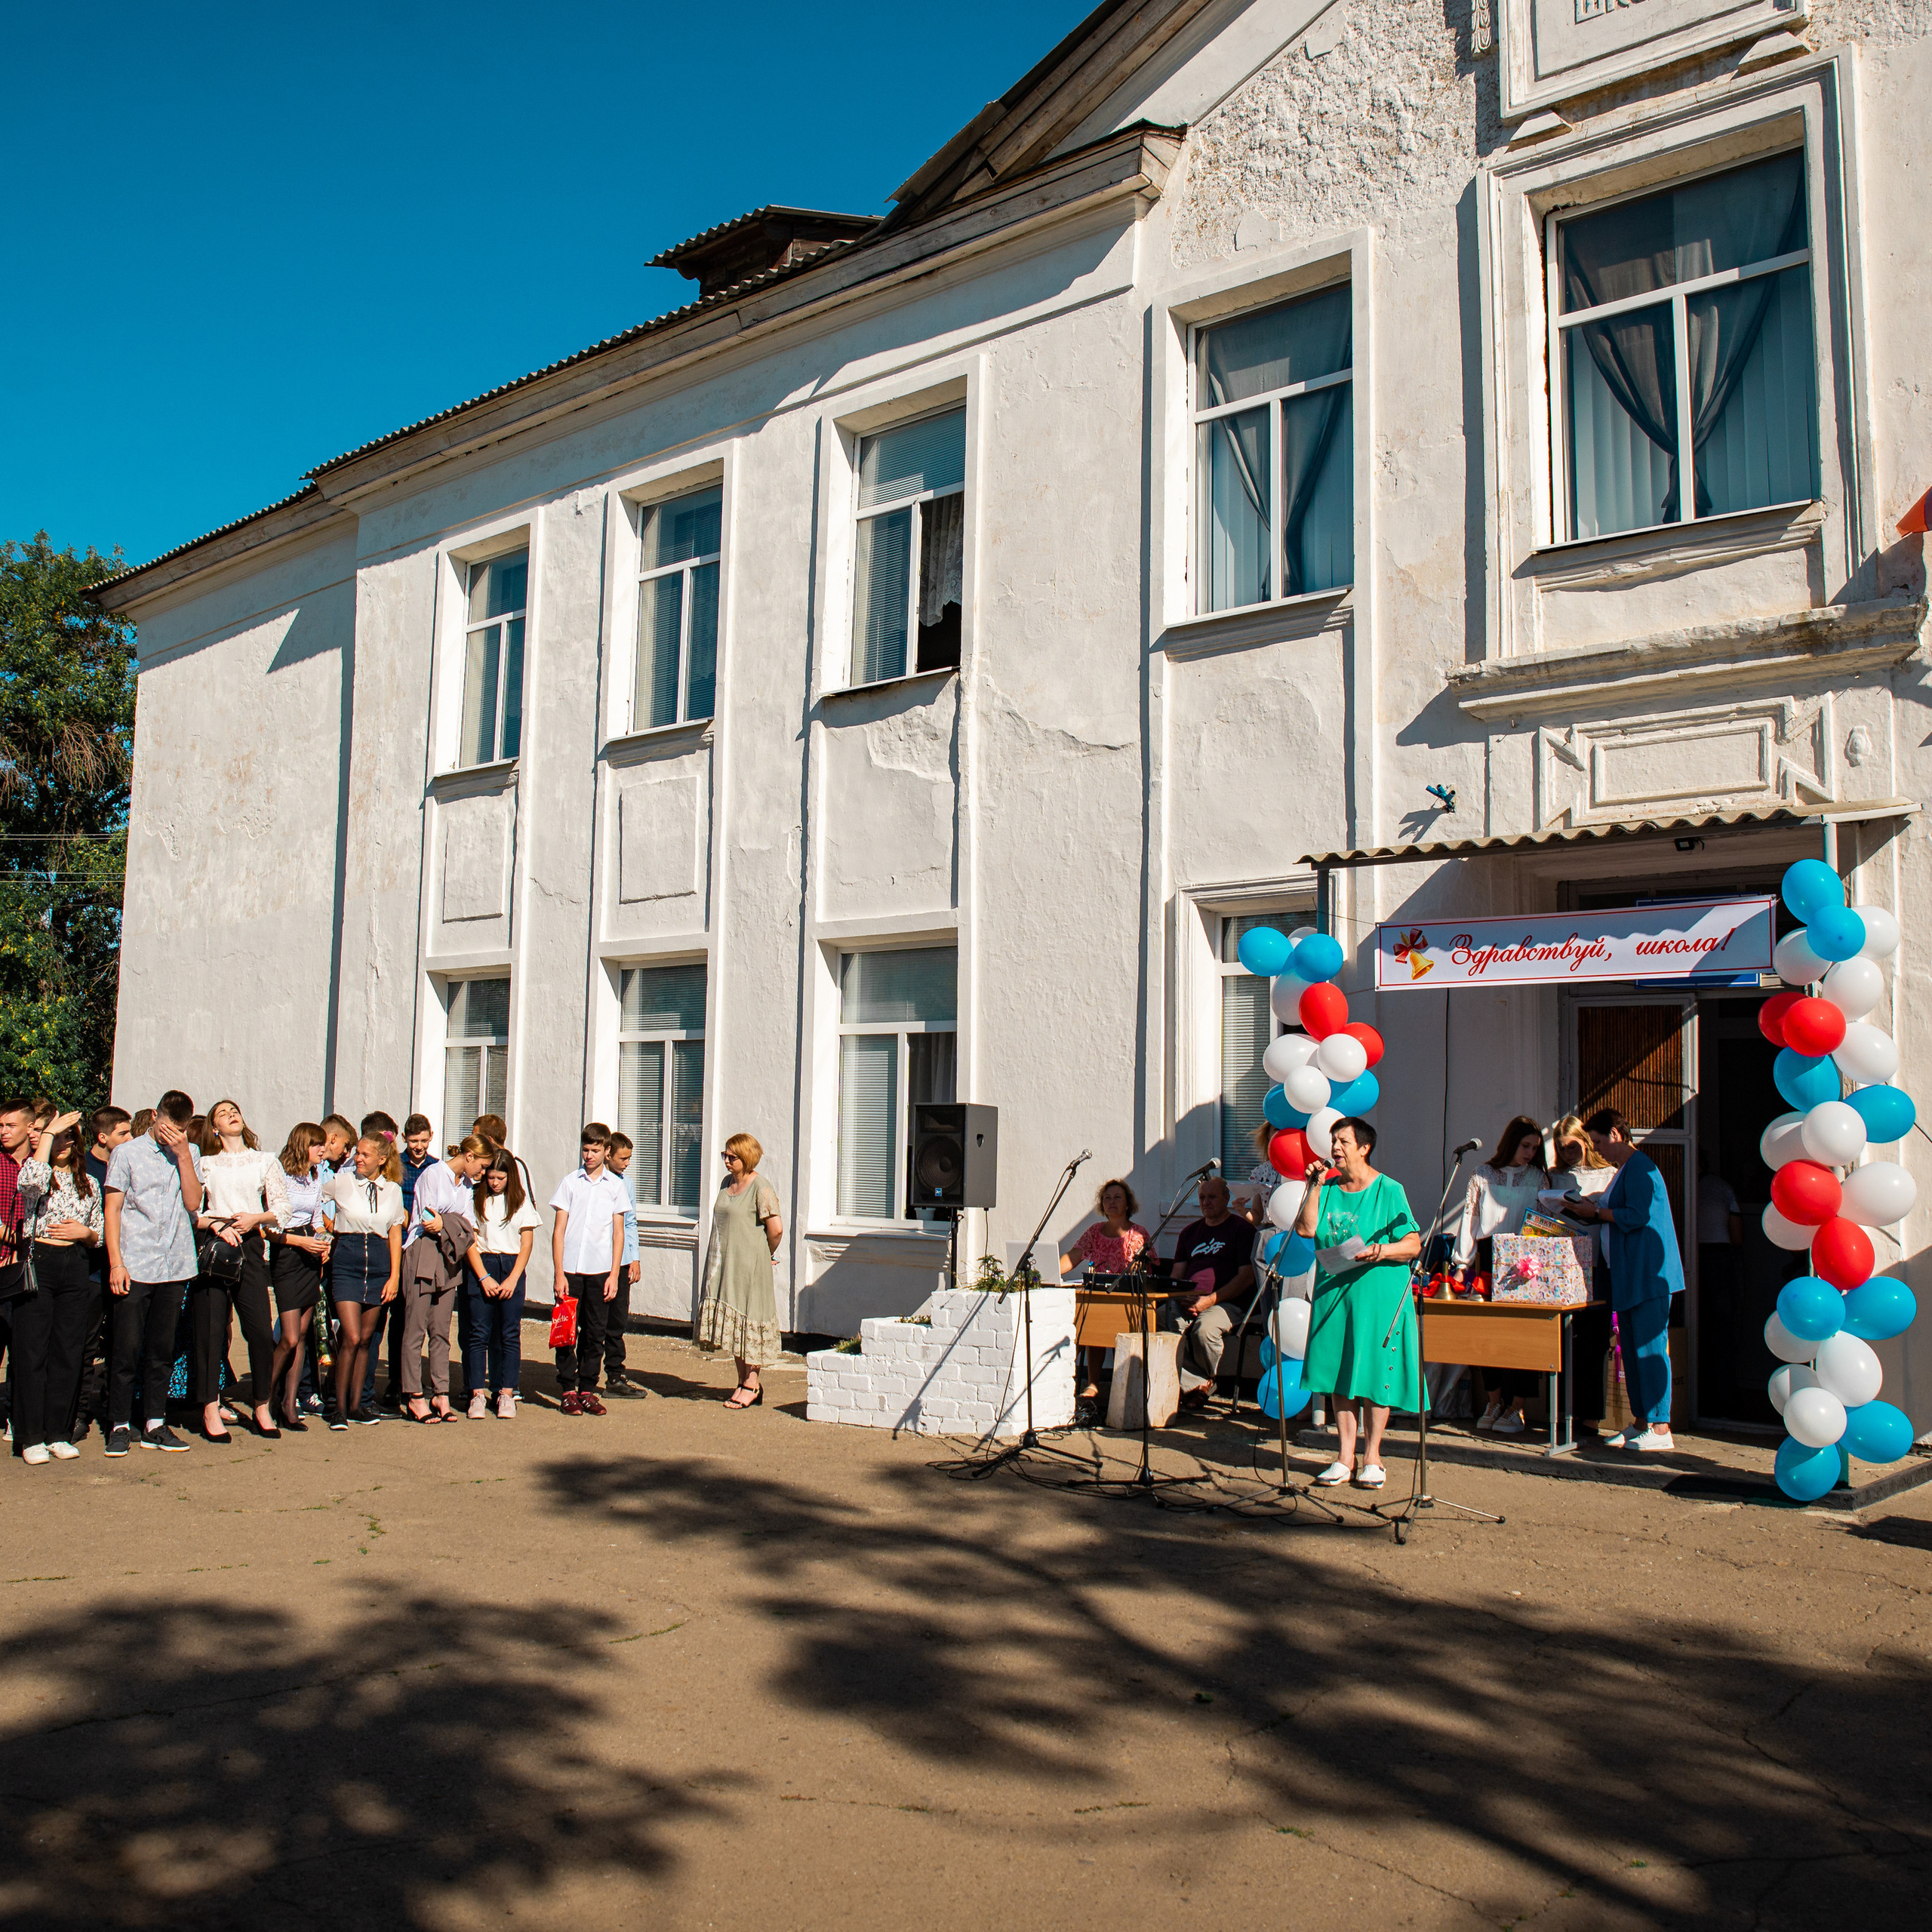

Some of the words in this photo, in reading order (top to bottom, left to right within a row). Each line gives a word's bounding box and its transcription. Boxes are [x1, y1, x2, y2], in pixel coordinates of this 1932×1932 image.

[1448, 933, 1612, 976] Здравствуй,
[1635, 928, 1736, 955] школа!
[1534, 1215, 1577, 1236] ВИКТОРИНА
